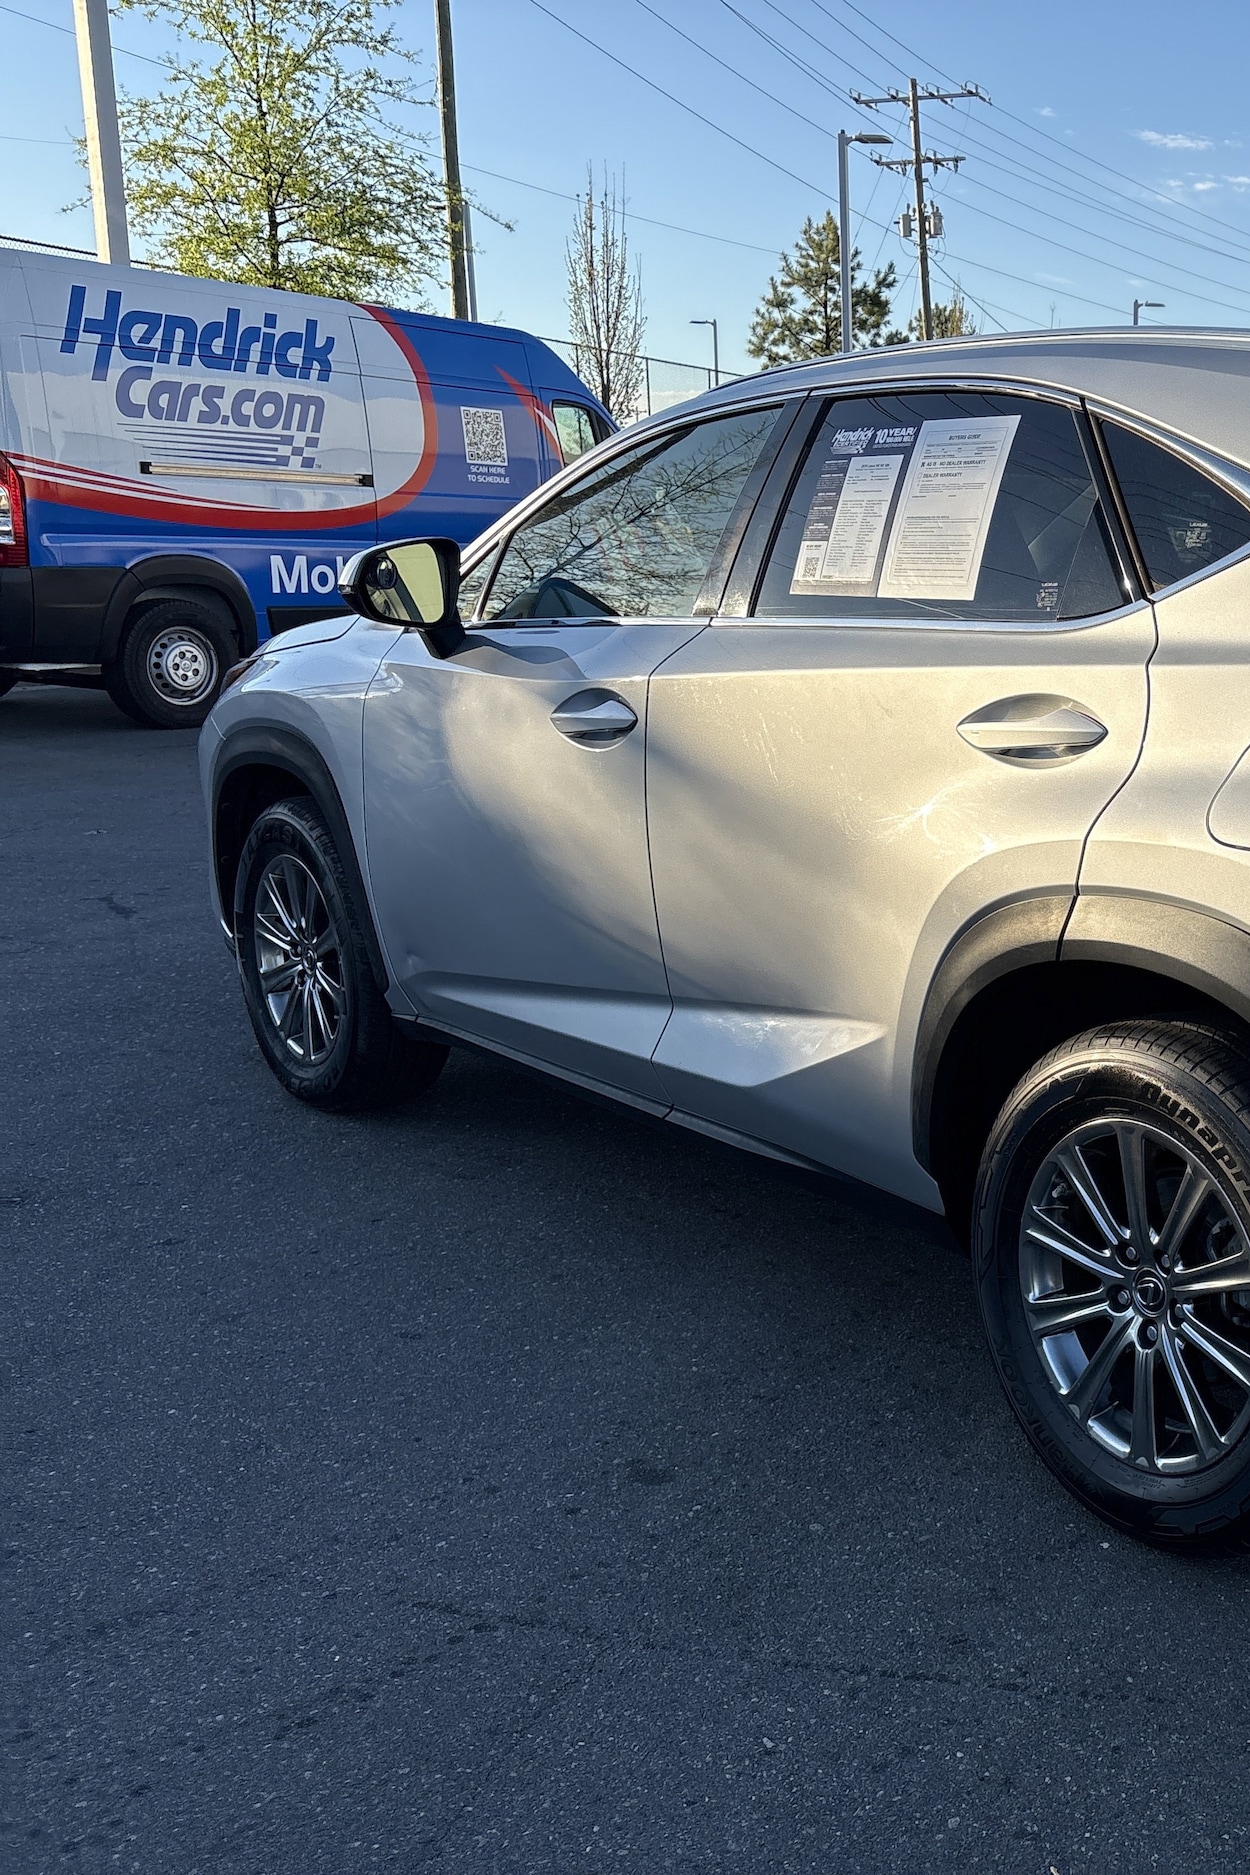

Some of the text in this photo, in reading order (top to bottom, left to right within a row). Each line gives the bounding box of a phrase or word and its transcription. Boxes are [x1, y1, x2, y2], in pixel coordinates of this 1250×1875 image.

[59, 284, 336, 382] Hendrick
[115, 365, 326, 434] Cars.com
[874, 428, 889, 444] 10
[470, 465, 506, 475] SCAN HERE
[467, 474, 510, 484] TO SCHEDULE
